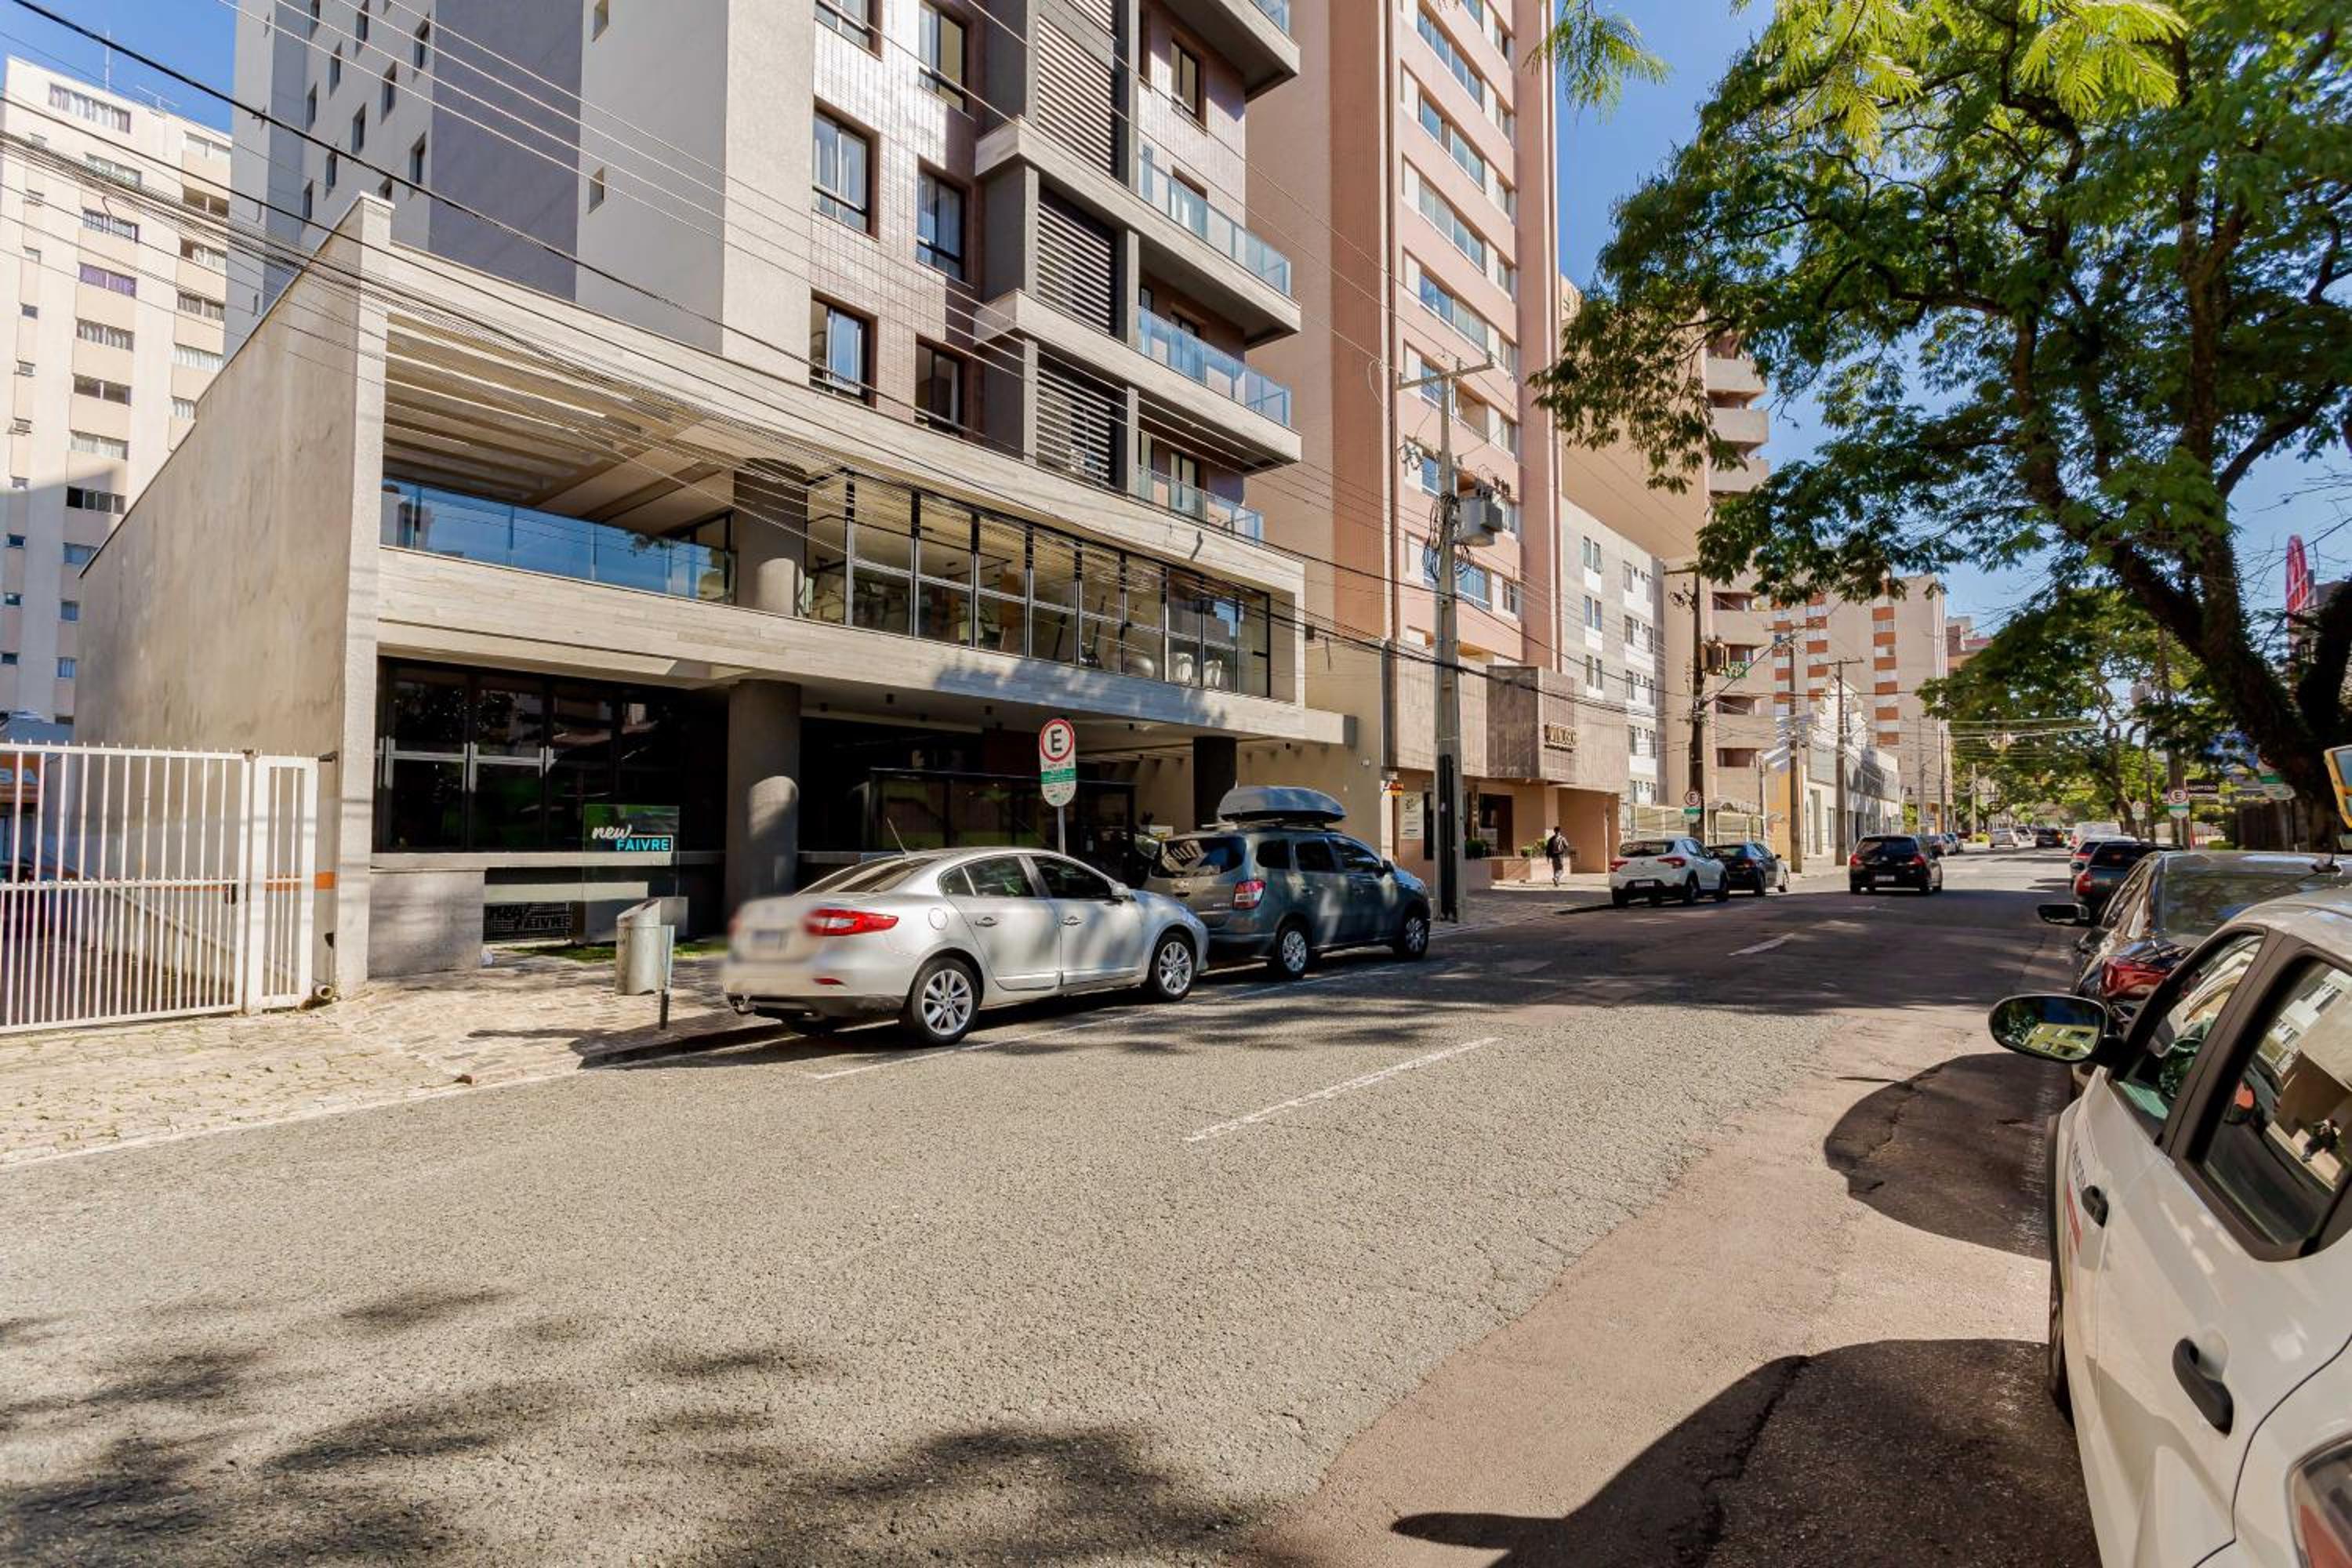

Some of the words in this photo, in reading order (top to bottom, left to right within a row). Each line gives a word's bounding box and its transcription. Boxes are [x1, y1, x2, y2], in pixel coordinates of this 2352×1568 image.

[1051, 729, 1062, 753] E
[591, 823, 632, 840] new
[615, 839, 670, 851] FAIVRE
